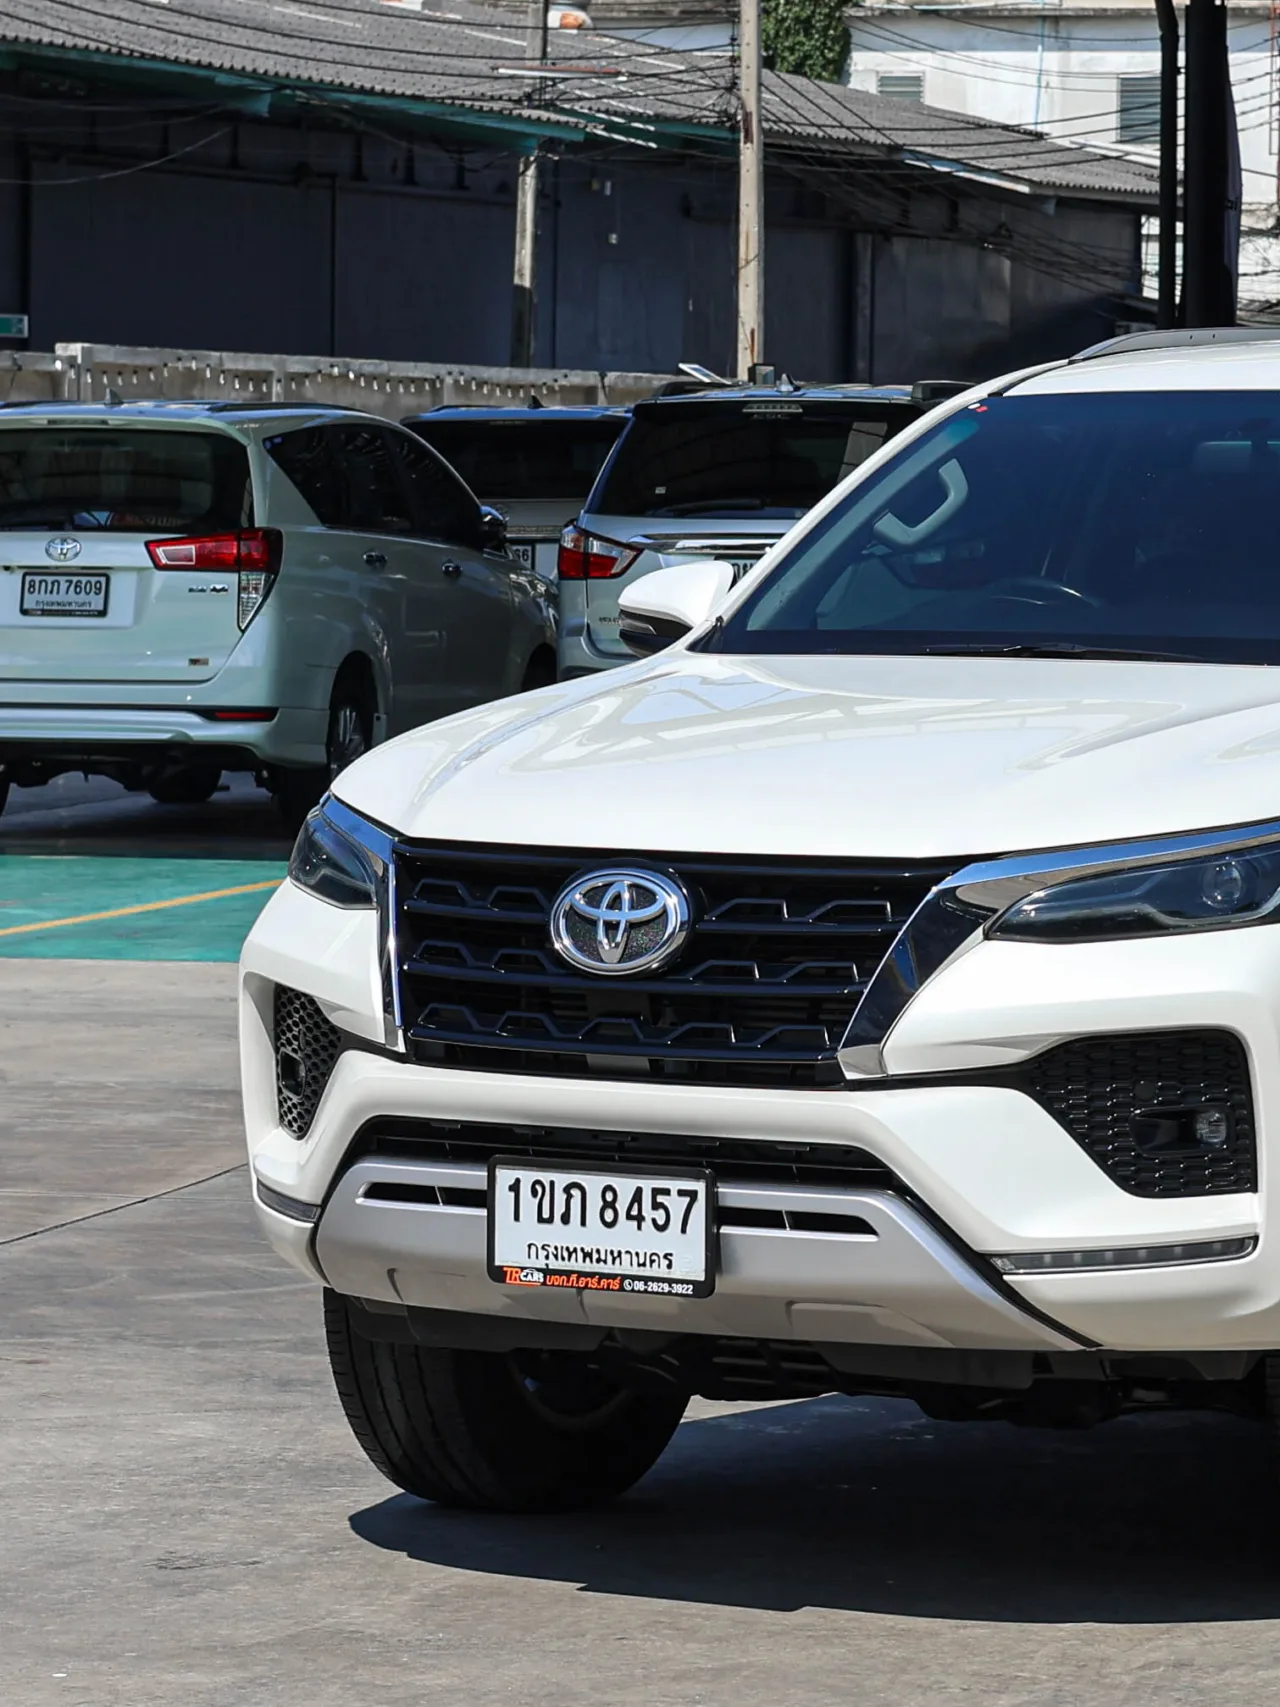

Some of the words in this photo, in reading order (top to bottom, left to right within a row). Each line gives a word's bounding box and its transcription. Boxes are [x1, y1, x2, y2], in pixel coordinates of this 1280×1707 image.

[64, 579, 103, 596] 7609
[508, 1177, 588, 1228] 1ขภ
[599, 1184, 699, 1235] 8457
[527, 1242, 674, 1271] กรุงเทพมหานคร
